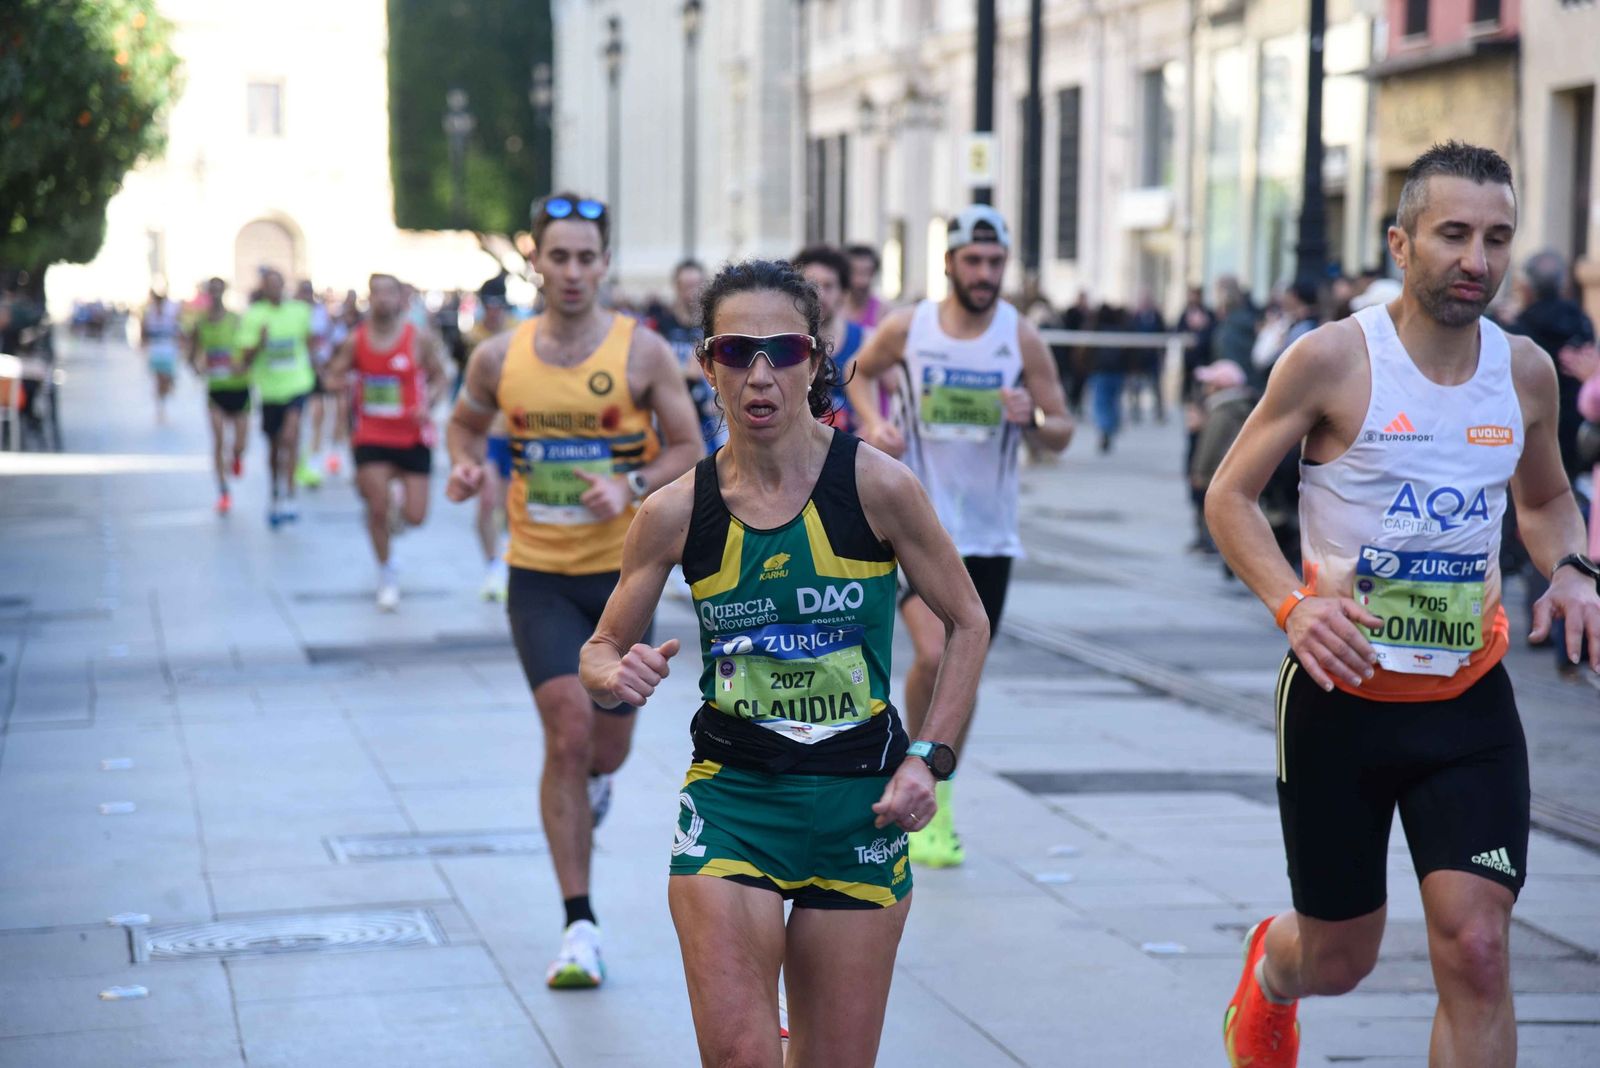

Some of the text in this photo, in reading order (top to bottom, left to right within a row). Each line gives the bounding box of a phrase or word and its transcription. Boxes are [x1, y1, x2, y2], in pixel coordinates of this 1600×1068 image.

[1379, 434, 1434, 442] EUROSPORT
[1470, 428, 1511, 439] EVOLVE
[1387, 482, 1490, 532] AQA
[1384, 518, 1435, 533] CAPITAL
[759, 570, 789, 581] KARHU
[796, 581, 864, 615] DAO
[1409, 594, 1448, 613] 1705
[700, 598, 777, 631] QUERCIA
[719, 612, 779, 631] Rovereto
[763, 629, 845, 653] ZURICH
[770, 671, 815, 690] 2027
[734, 692, 858, 723] CLAUDIA
[1471, 855, 1517, 877] adidas
